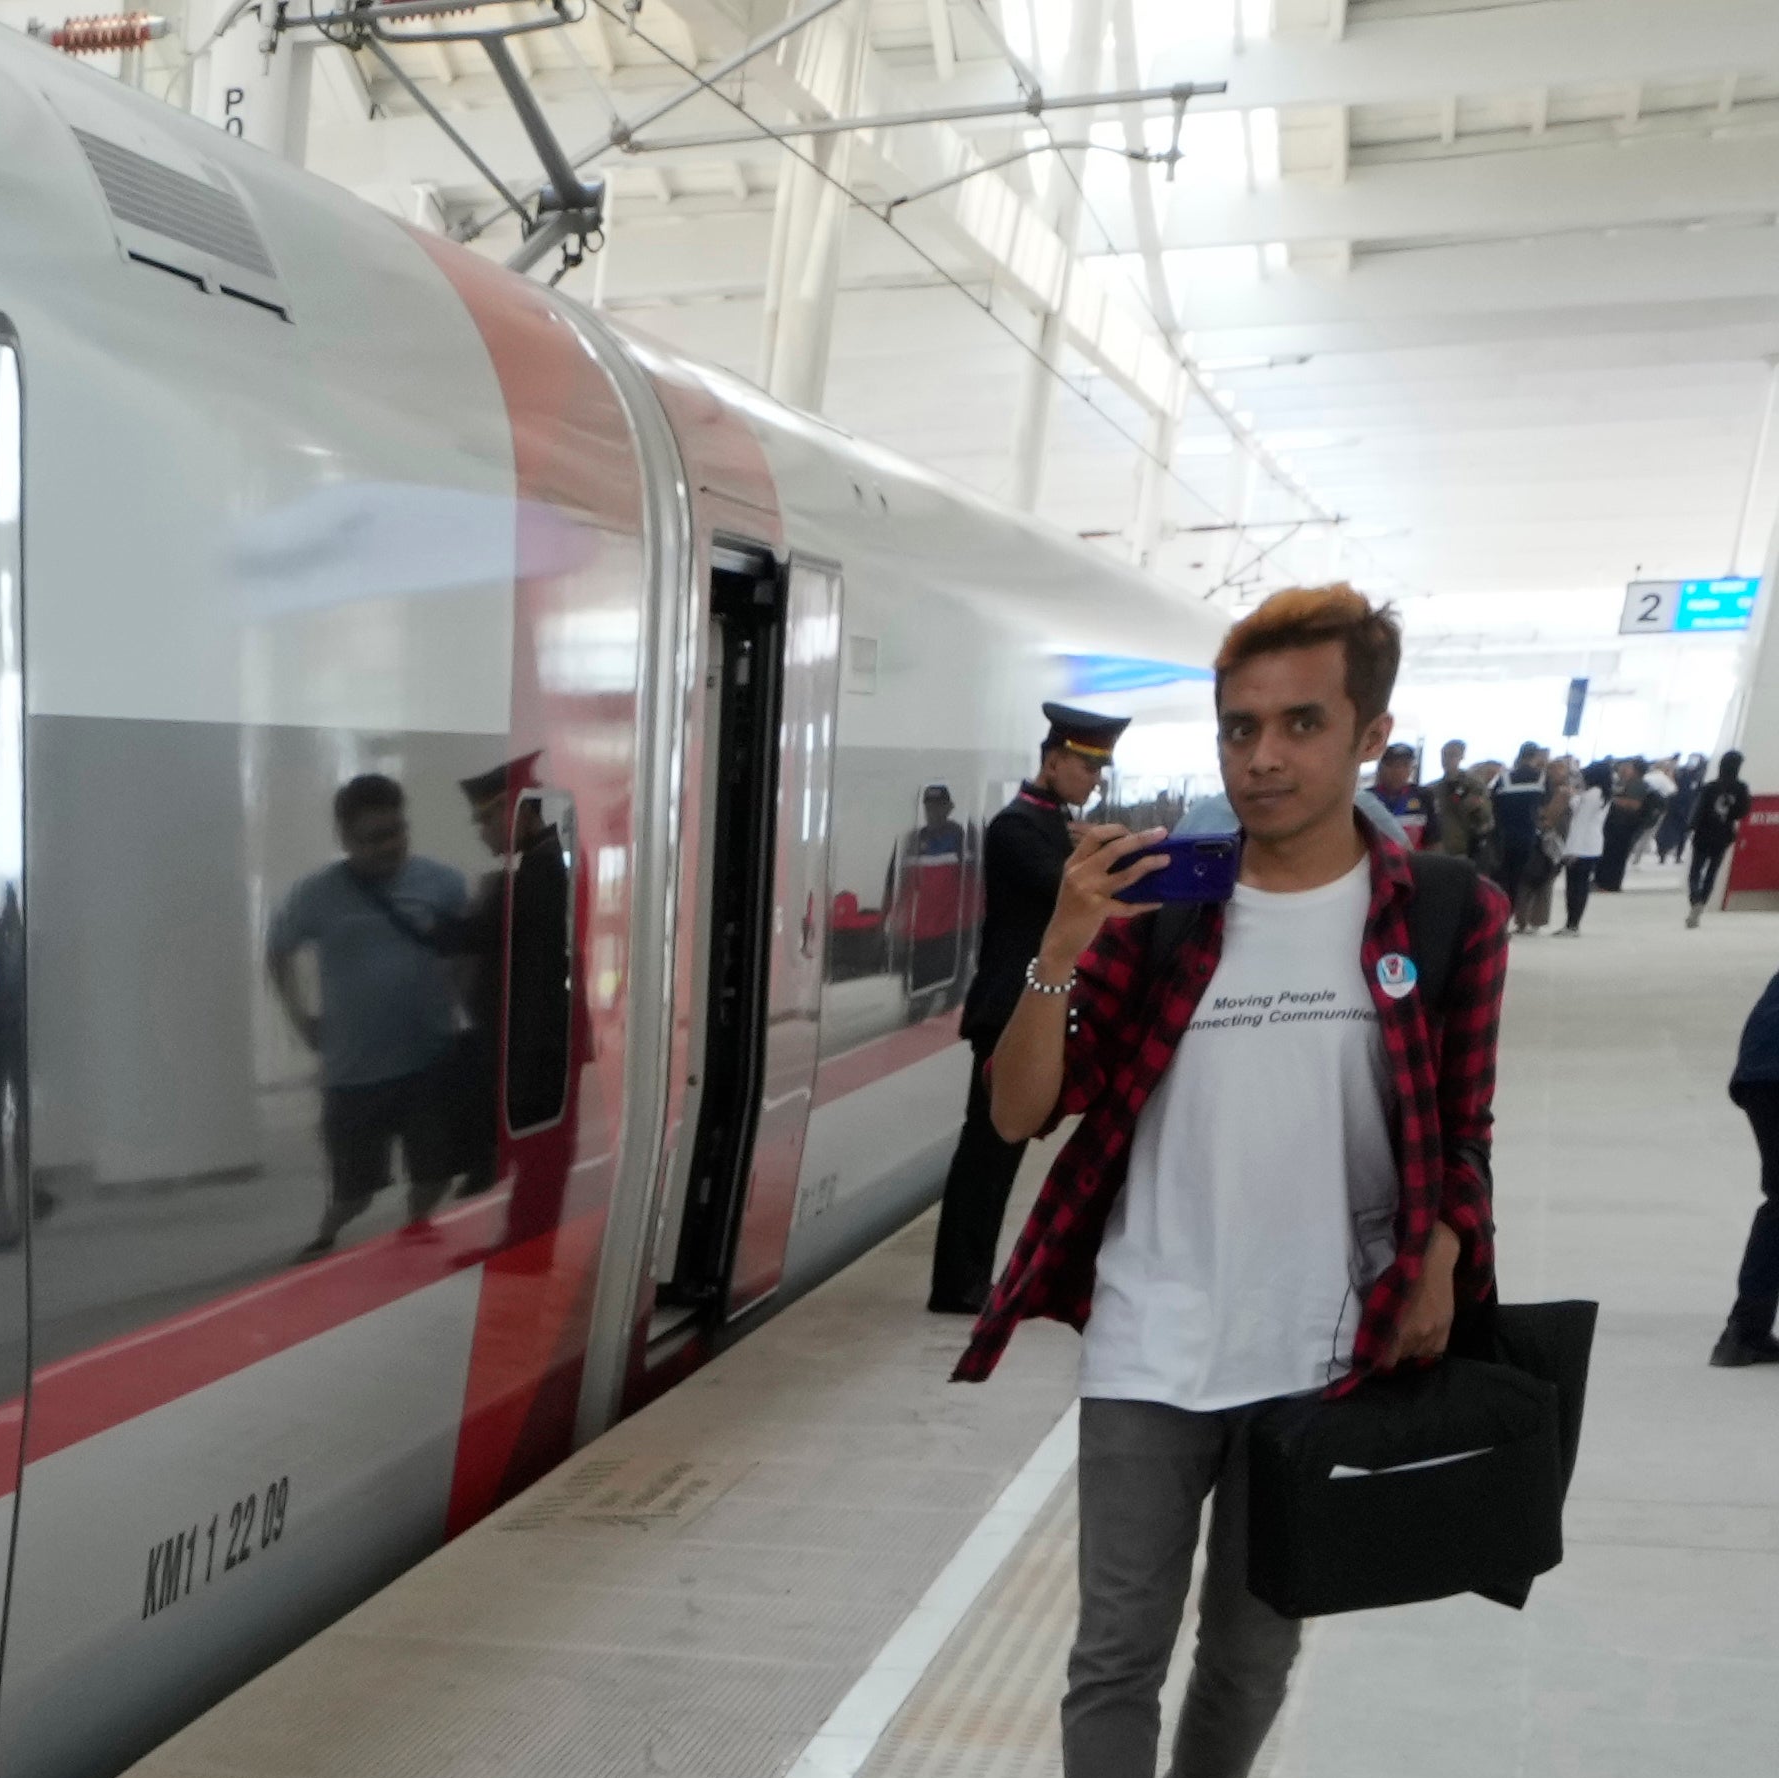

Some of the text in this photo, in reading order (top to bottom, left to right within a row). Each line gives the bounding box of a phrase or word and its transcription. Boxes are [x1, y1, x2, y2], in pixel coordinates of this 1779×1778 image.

[1636, 592, 1662, 622] 2
[1212, 989, 1337, 1011] Moving People
